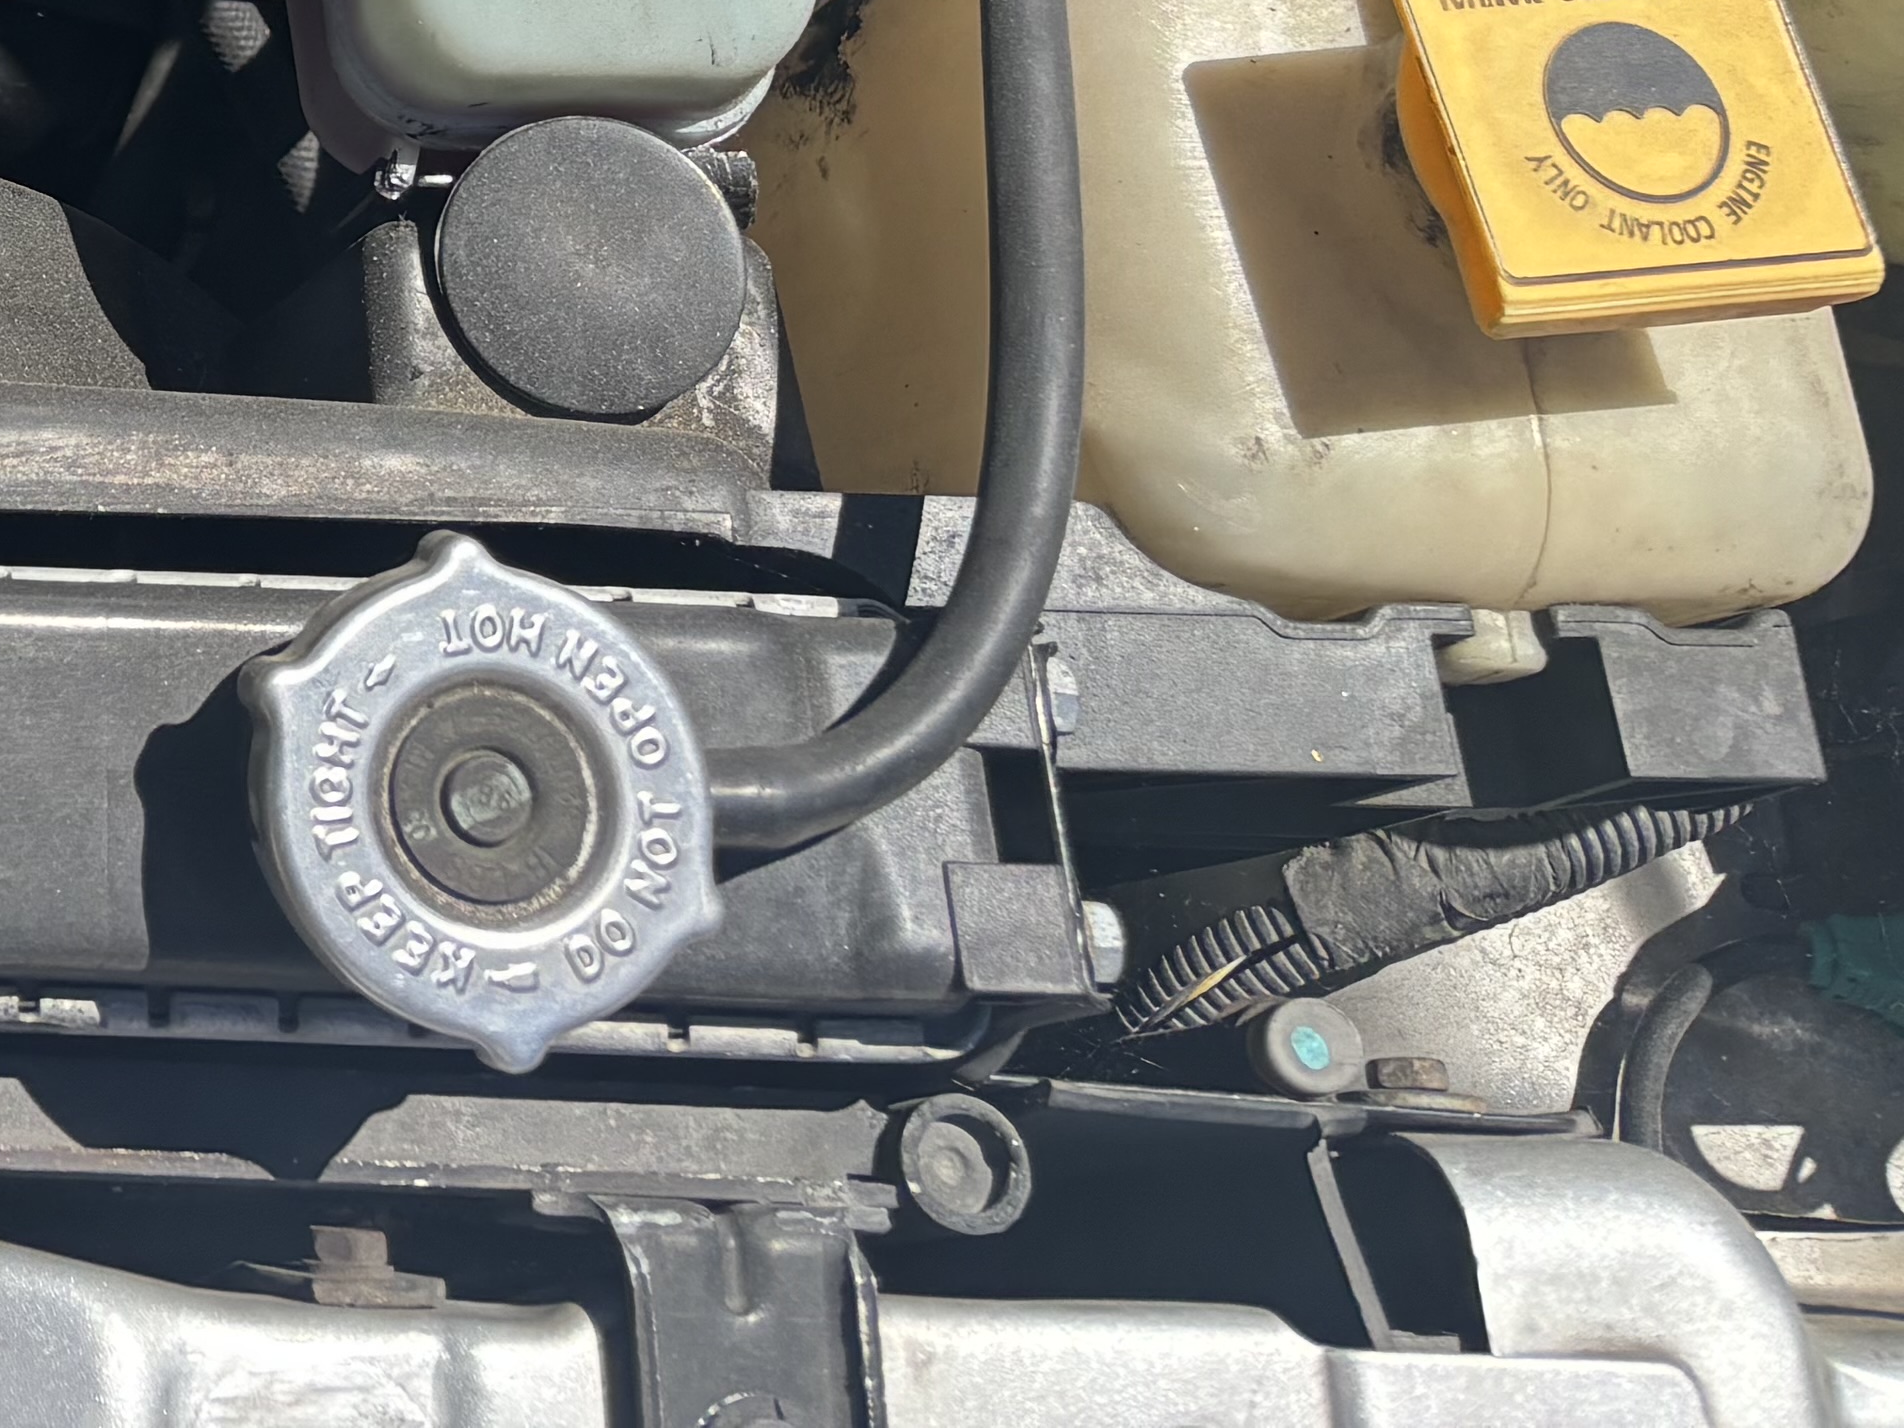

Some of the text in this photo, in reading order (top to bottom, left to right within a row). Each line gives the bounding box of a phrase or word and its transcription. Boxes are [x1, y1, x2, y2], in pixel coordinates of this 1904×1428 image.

[1523, 139, 1772, 246] ENGINE COOLANT ONLY
[436, 602, 548, 656] HOT
[550, 628, 670, 770] OPEN
[309, 687, 477, 991] KEEP TIGHT
[623, 789, 682, 912] NOT
[563, 907, 637, 983] DO
